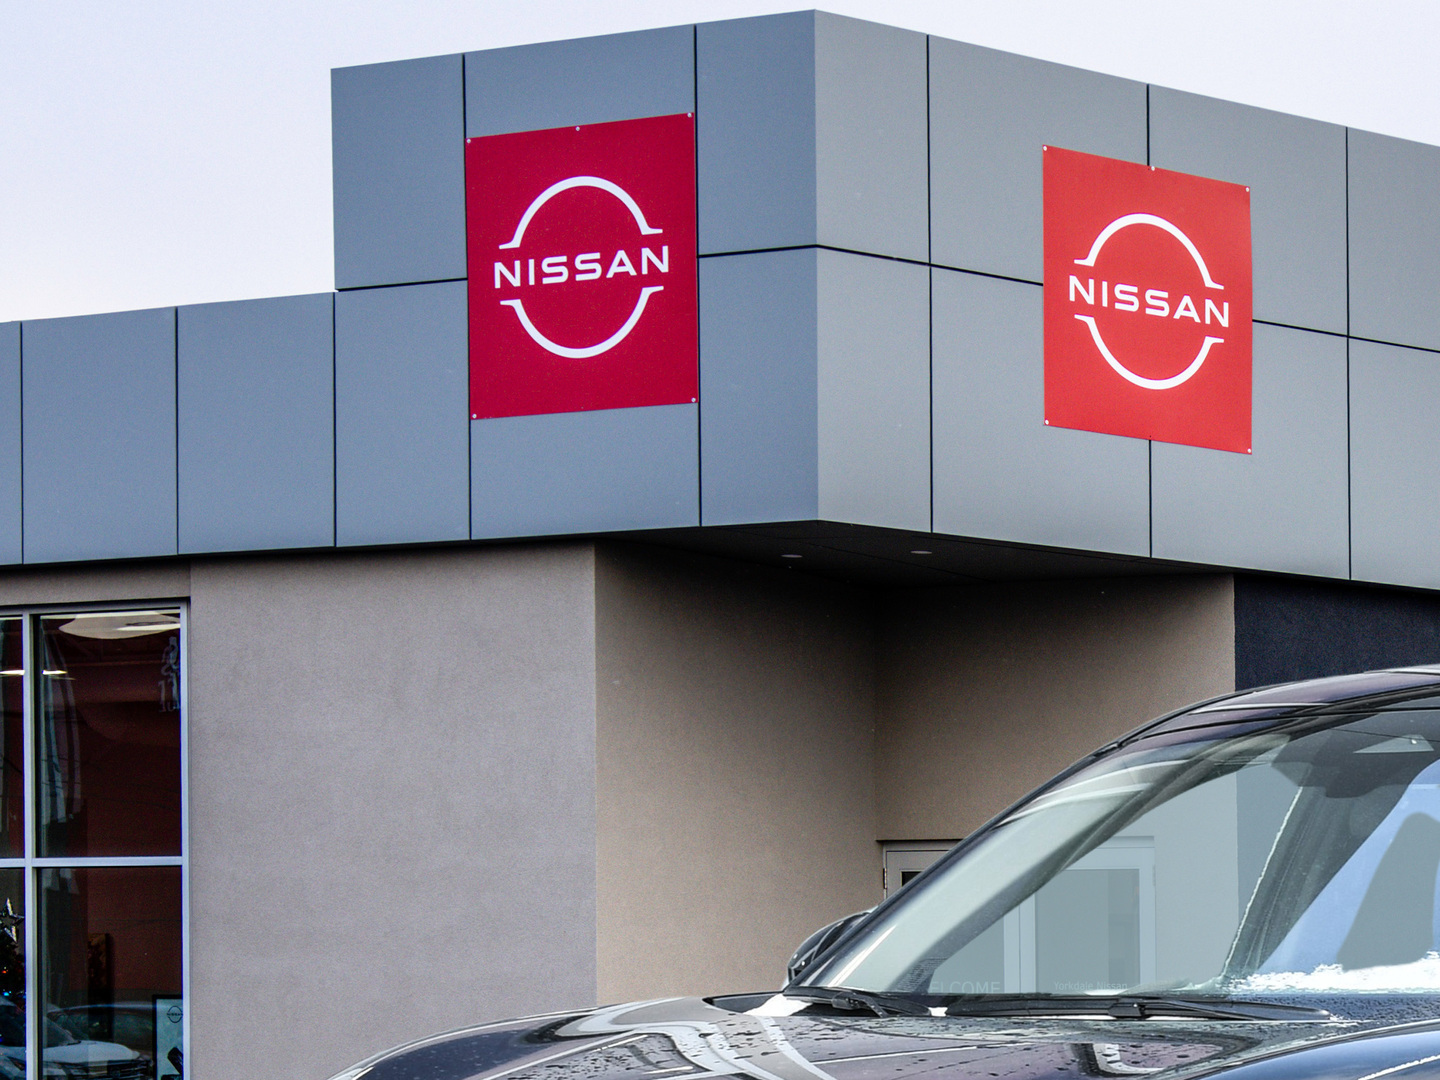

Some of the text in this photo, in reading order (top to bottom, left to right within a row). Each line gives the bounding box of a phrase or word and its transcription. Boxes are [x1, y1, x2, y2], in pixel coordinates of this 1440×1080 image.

[494, 245, 669, 289] NISSAN
[1069, 275, 1229, 328] NISSAN
[929, 981, 1001, 993] ELCOME
